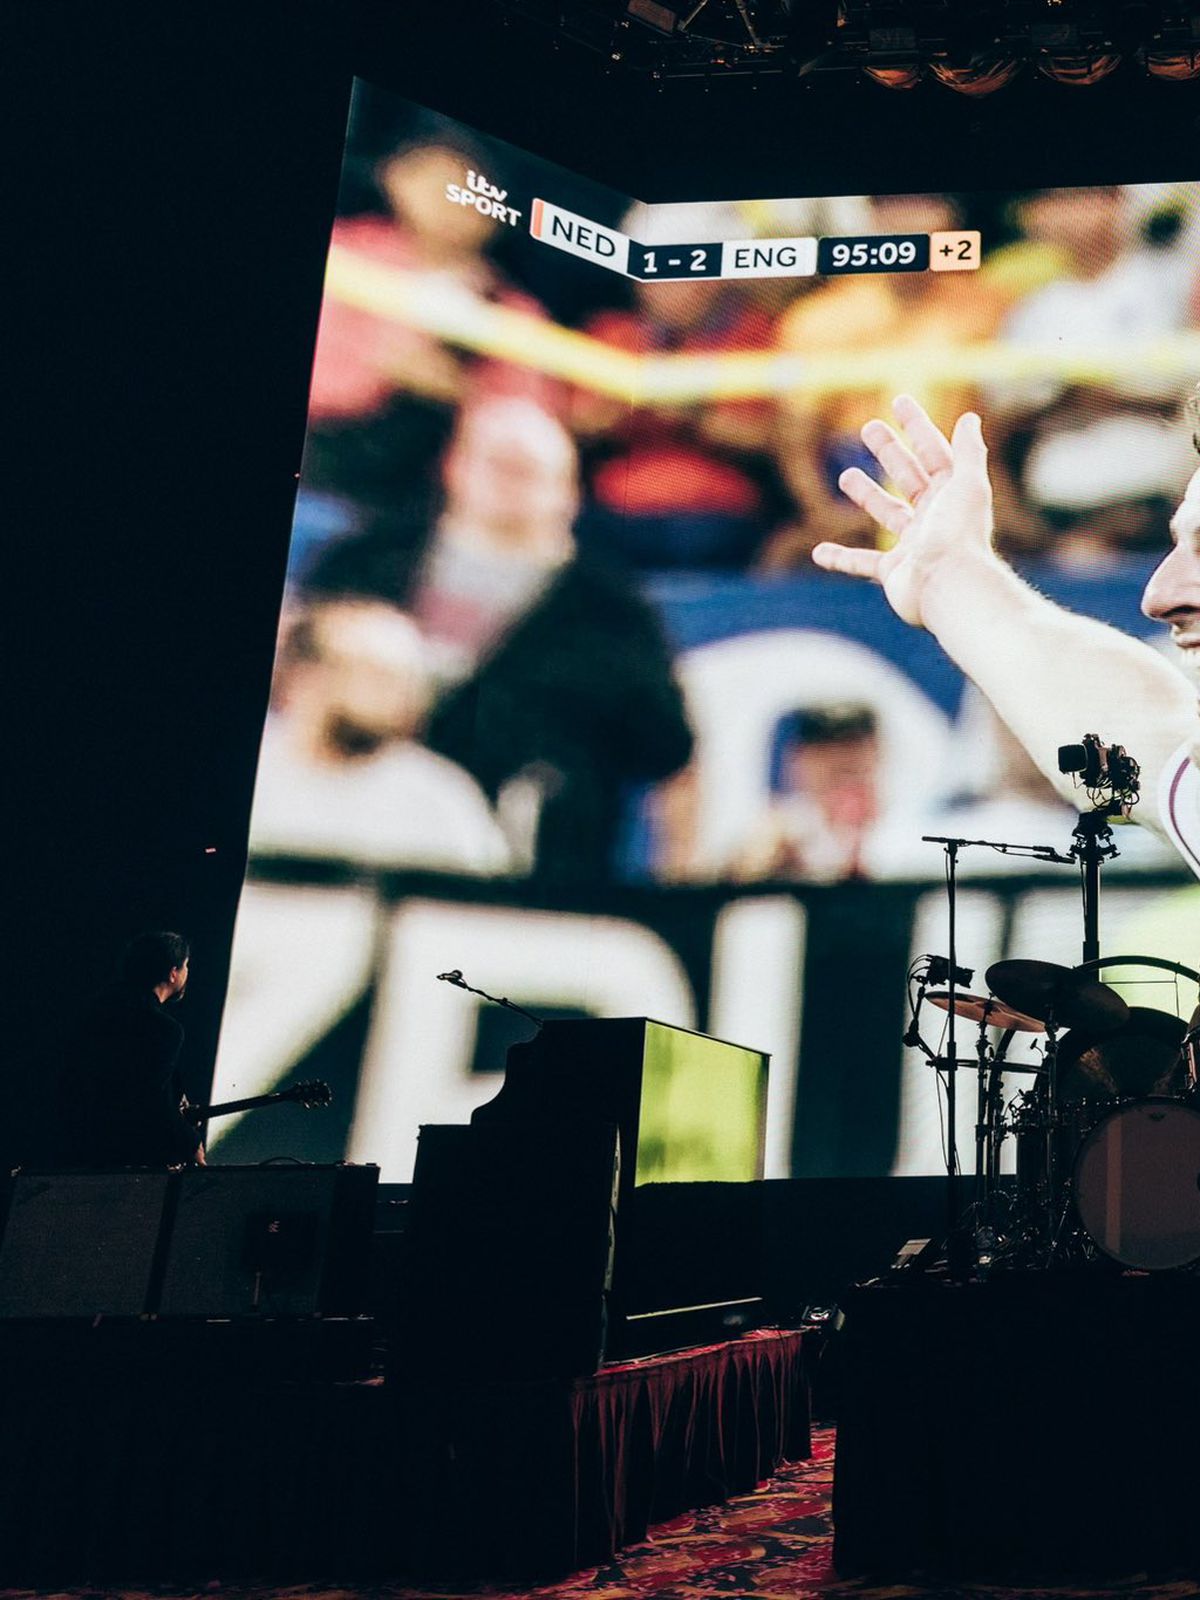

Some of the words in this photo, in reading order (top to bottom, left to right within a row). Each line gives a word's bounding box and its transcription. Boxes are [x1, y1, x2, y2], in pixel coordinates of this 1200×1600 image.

[446, 184, 522, 227] SPORT
[466, 170, 508, 202] itv
[552, 216, 616, 257] NED
[643, 252, 658, 273] 1
[690, 250, 707, 272] 2
[735, 247, 798, 269] ENG
[832, 241, 917, 267] 95:09
[939, 240, 973, 261] +2
